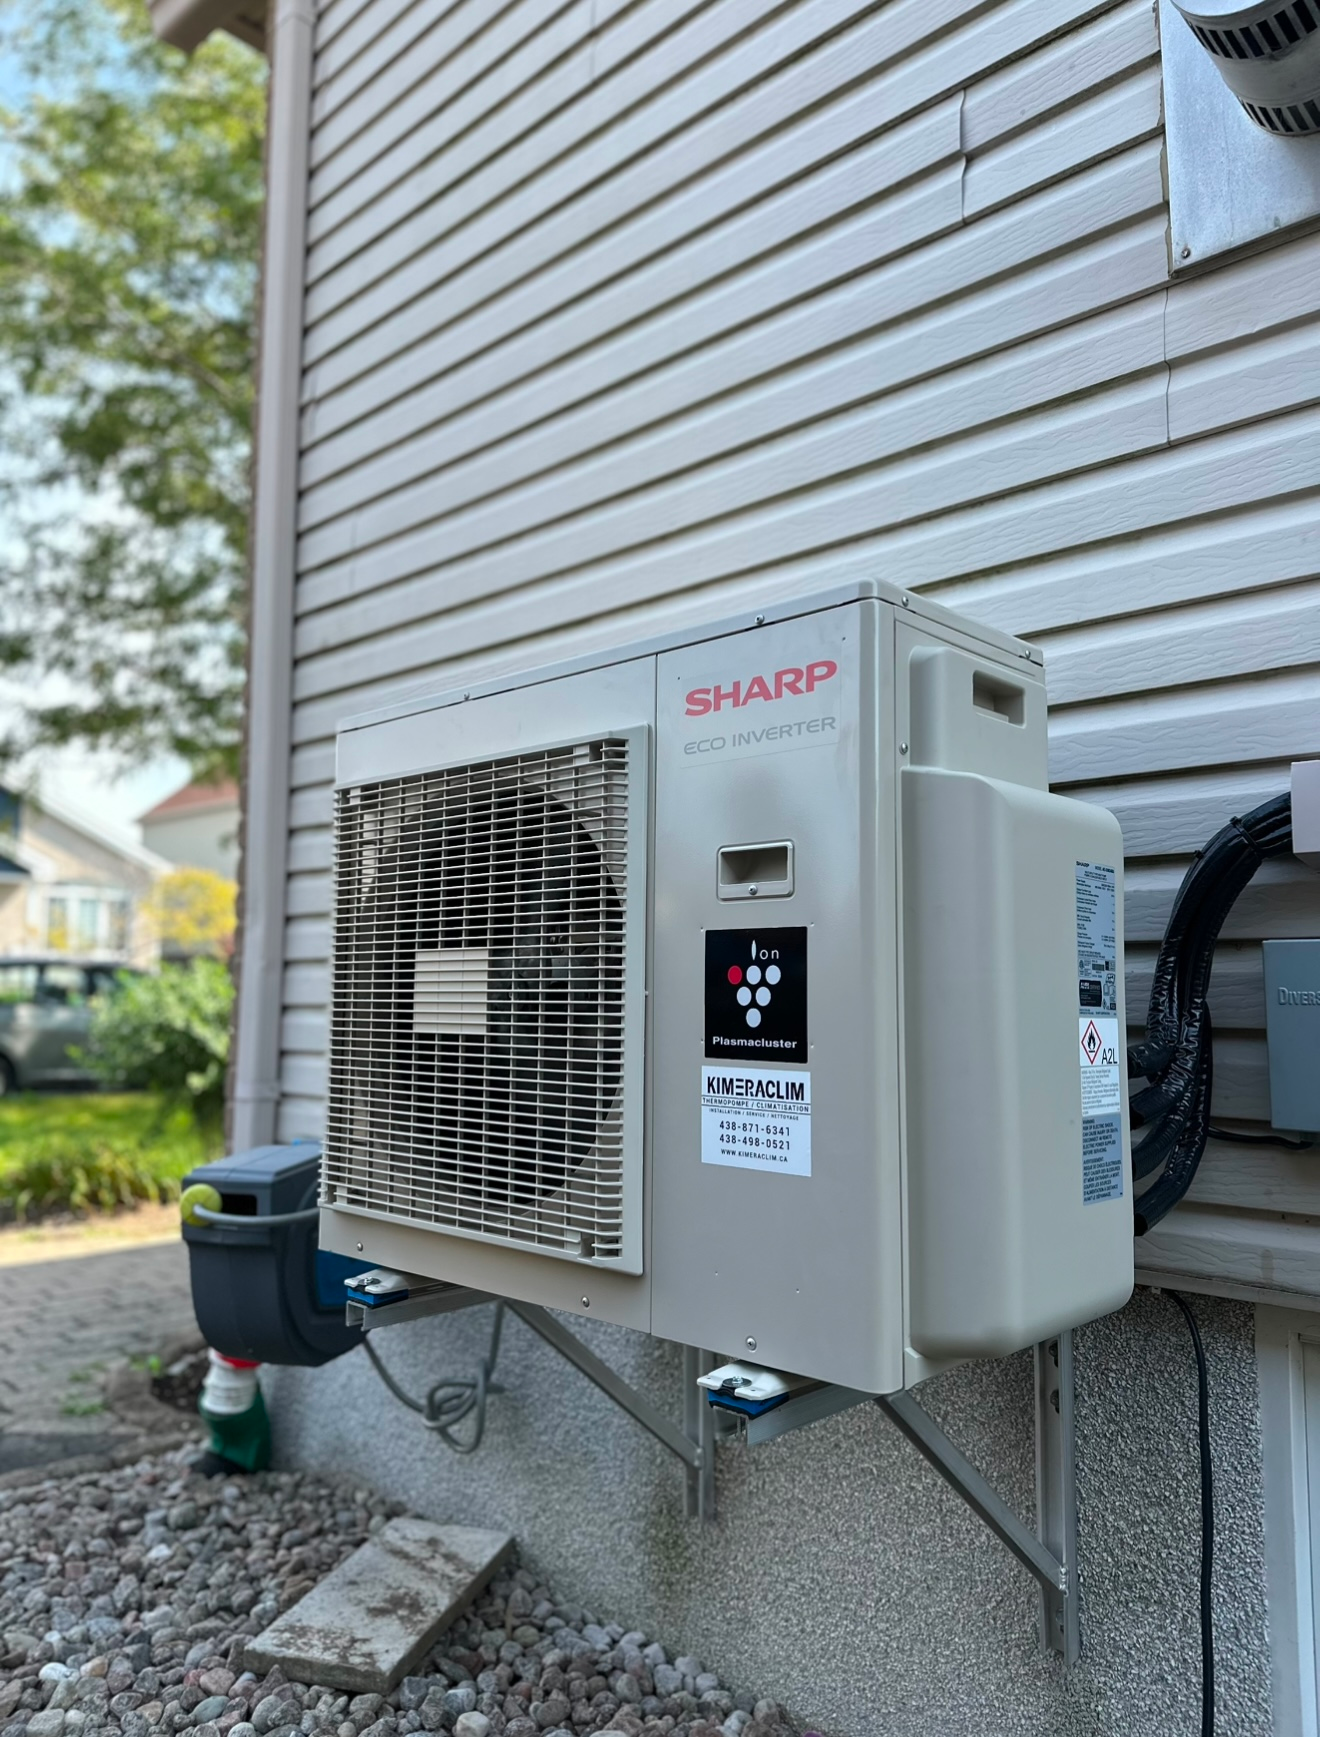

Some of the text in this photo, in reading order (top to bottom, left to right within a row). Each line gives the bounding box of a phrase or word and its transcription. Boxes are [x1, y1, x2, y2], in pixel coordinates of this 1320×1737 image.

[685, 660, 838, 717] SHARP
[683, 716, 837, 755] ECO INVERTER
[712, 1036, 798, 1049] Plasmacluster
[1101, 1048, 1118, 1065] A2L
[707, 1076, 805, 1101] KIMERACLIM
[703, 1097, 749, 1108] THERMOPOMPE
[756, 1101, 810, 1113] CLIMATISATION
[709, 1107, 742, 1116] INSTALLATION
[771, 1113, 799, 1121] NETTOYAGE
[719, 1120, 790, 1136] 438-871-6341
[719, 1134, 790, 1150] 438-498-0521
[720, 1148, 788, 1163] WWW.KIMERACLIM.CA
